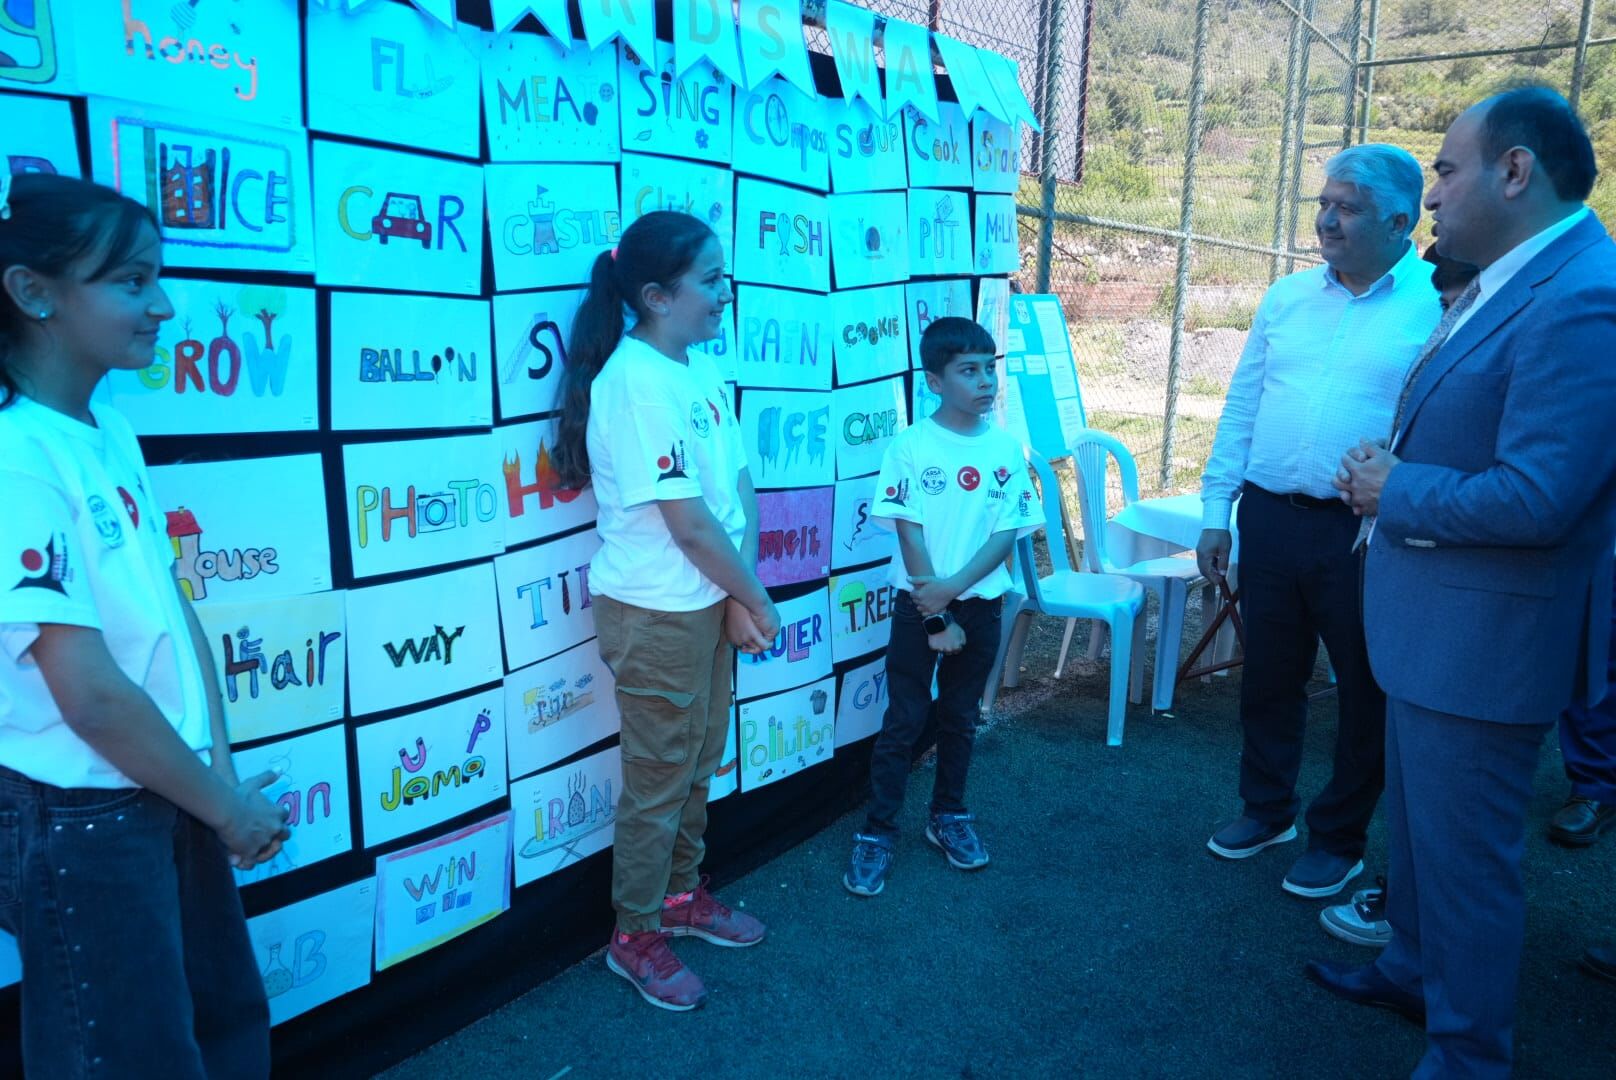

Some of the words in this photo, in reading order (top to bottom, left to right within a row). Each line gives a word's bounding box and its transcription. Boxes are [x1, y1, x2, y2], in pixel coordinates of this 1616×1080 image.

[120, 0, 257, 100] honey
[759, 210, 824, 257] FISH
[757, 404, 831, 472] ICE
[356, 478, 499, 549] PHOTO
[222, 629, 342, 703] Hair
[383, 624, 466, 668] WAY
